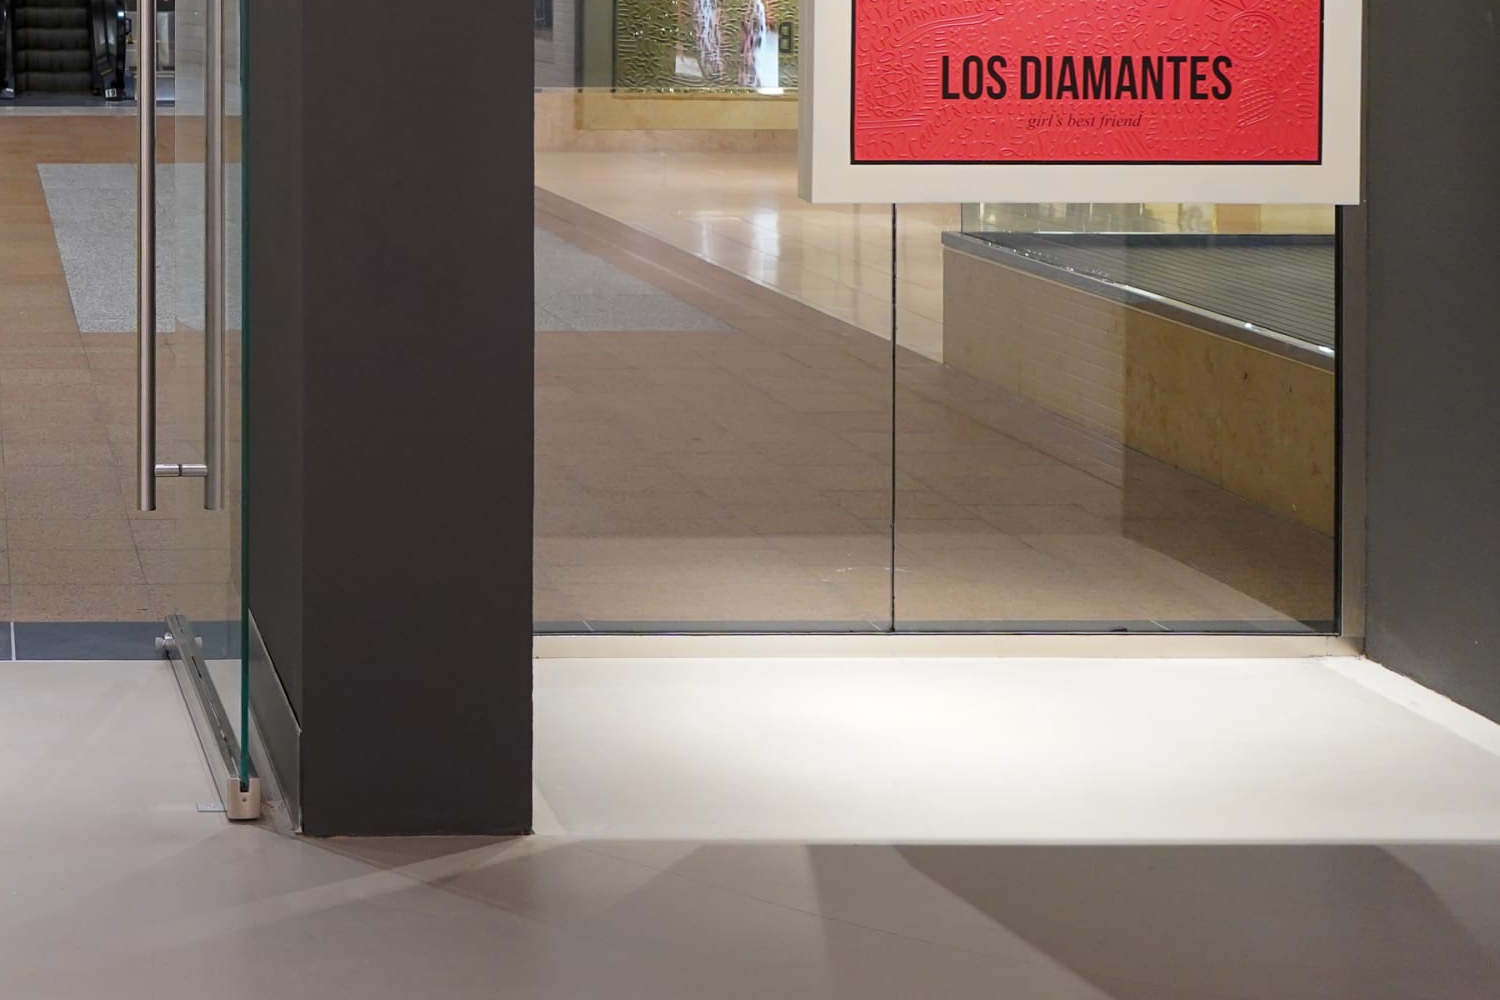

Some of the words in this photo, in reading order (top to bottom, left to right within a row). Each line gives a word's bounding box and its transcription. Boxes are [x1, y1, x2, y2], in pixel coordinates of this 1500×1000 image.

[941, 55, 1006, 100] LOS
[1020, 56, 1232, 100] DIAMANTES
[1028, 114, 1063, 129] girl's
[1067, 113, 1095, 127] best
[1099, 113, 1143, 129] friend
